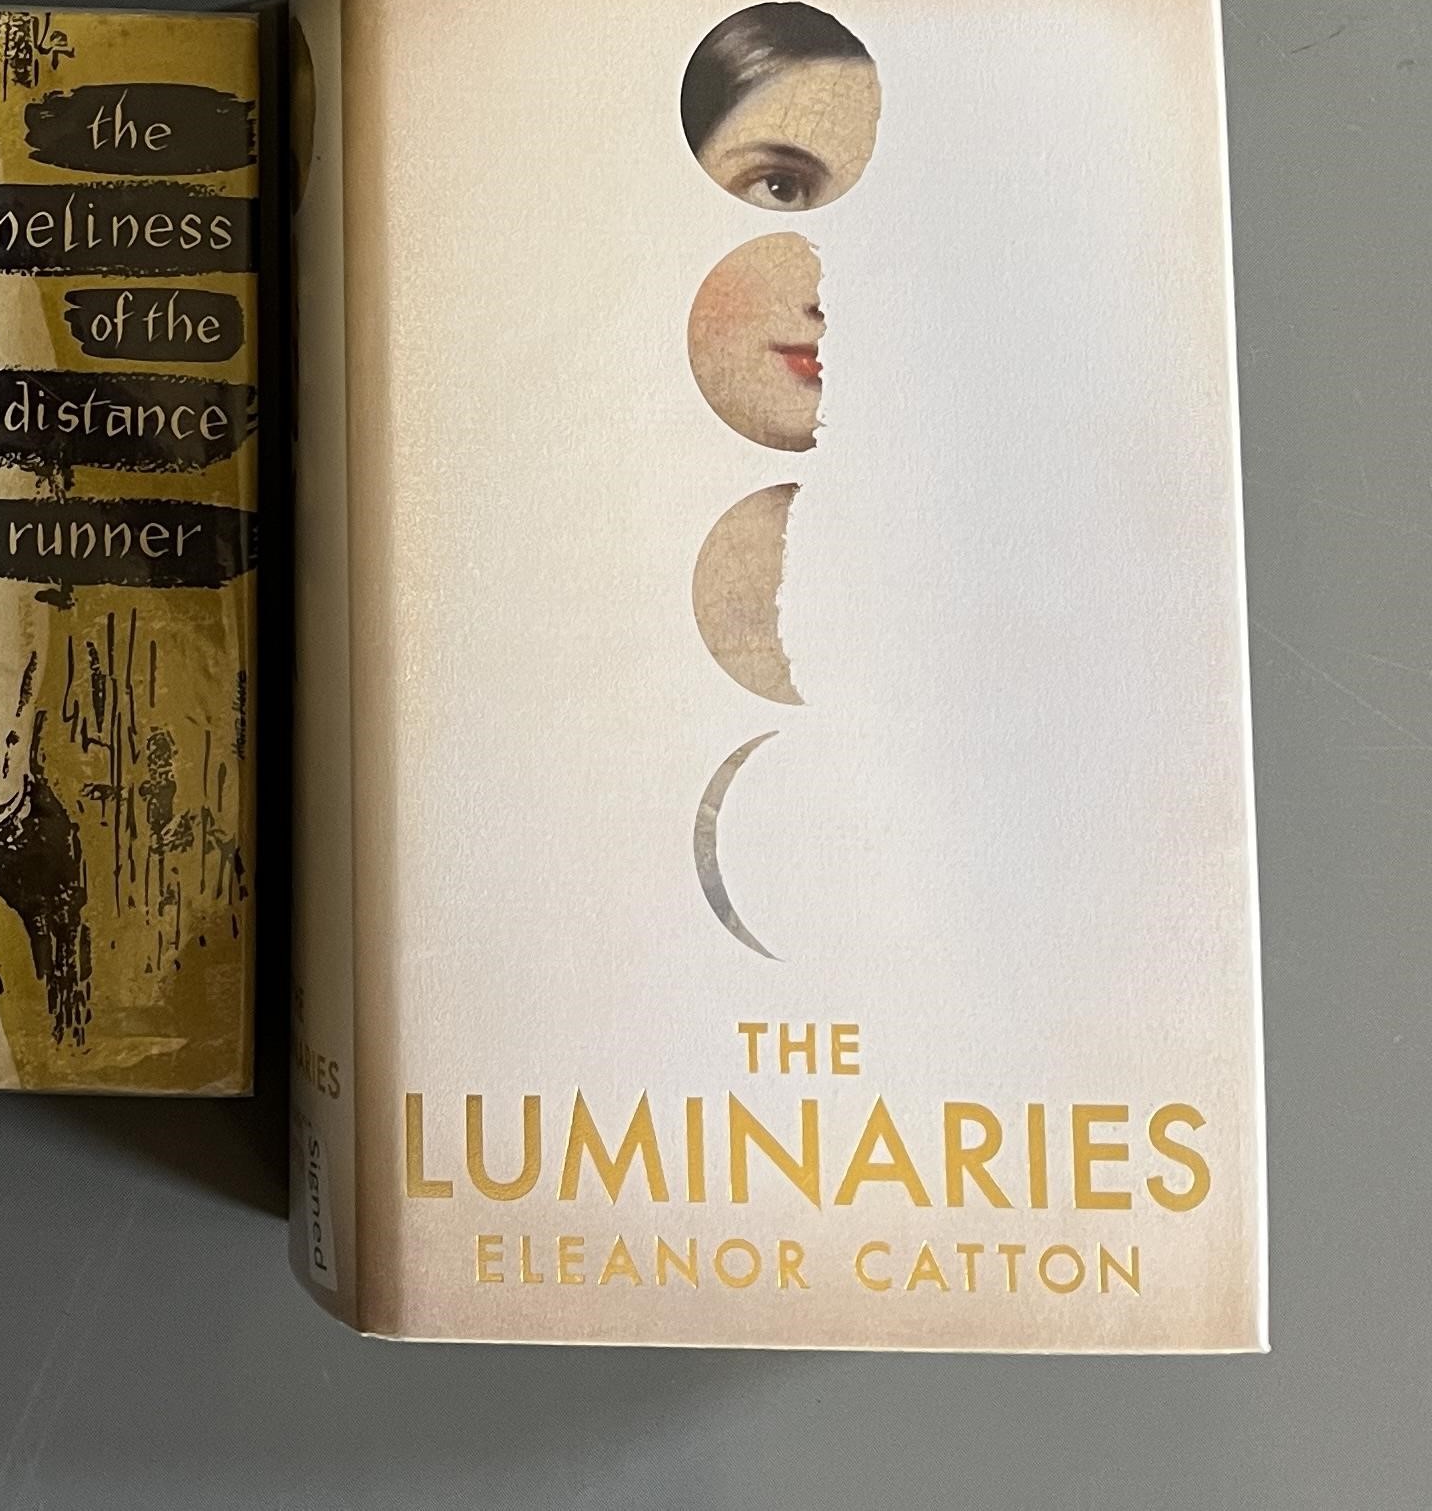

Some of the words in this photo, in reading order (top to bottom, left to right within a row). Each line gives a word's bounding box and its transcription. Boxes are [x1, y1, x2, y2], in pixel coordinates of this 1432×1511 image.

[87, 89, 172, 151] the
[90, 290, 134, 348] of
[142, 291, 221, 344] the
[7, 520, 202, 561] runner
[737, 1021, 861, 1076] THE
[404, 1086, 1212, 1213] LUMINARIES
[308, 1136, 328, 1272] Signed
[474, 1234, 811, 1292] ELEANOR
[854, 1240, 1145, 1296] CATTON
